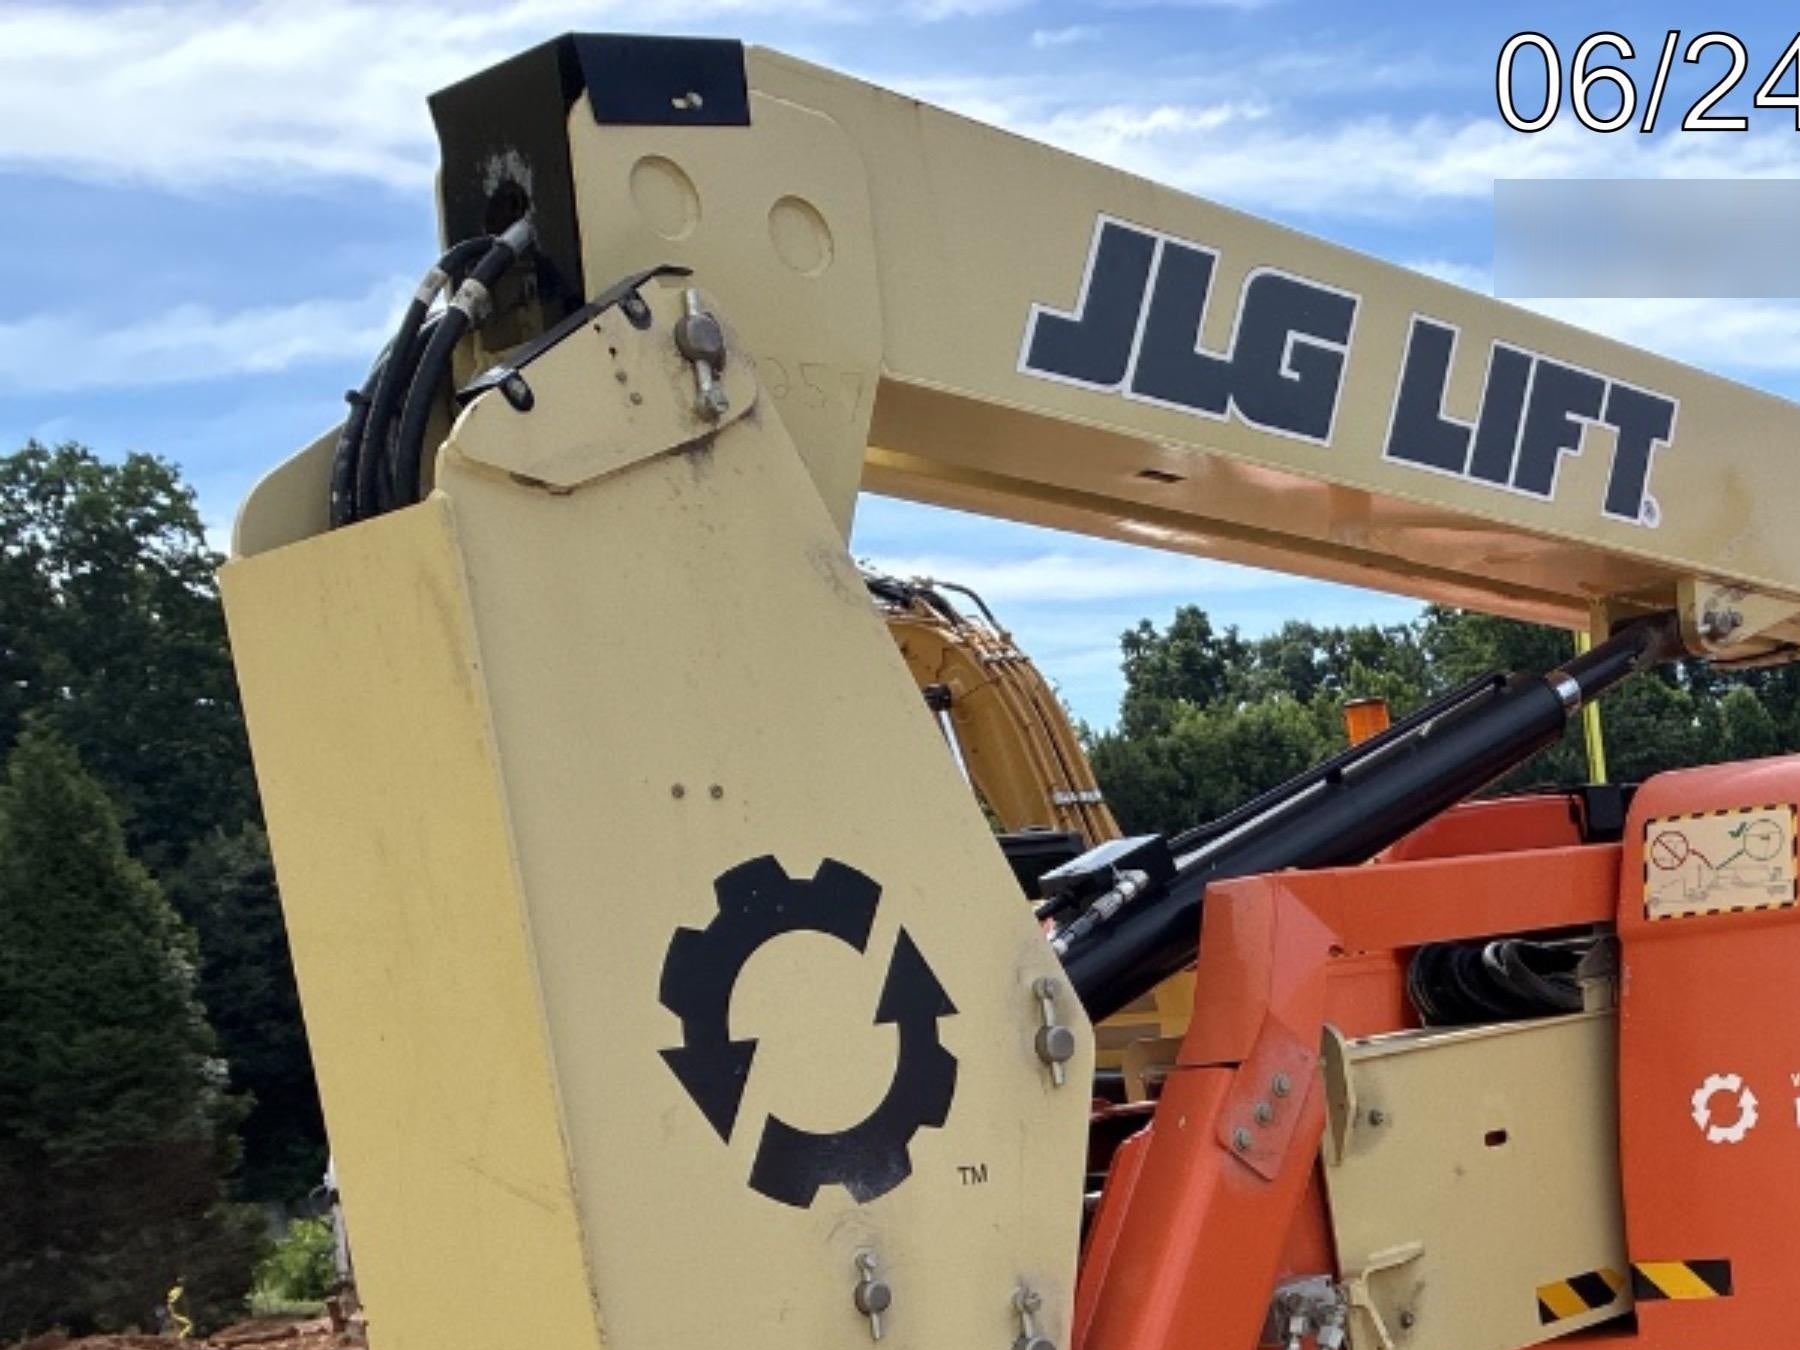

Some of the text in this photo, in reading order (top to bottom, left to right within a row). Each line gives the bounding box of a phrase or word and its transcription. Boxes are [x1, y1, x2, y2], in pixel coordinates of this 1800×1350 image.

[1016, 212, 1680, 528] JLG LIFT
[957, 1163, 989, 1186] TM
